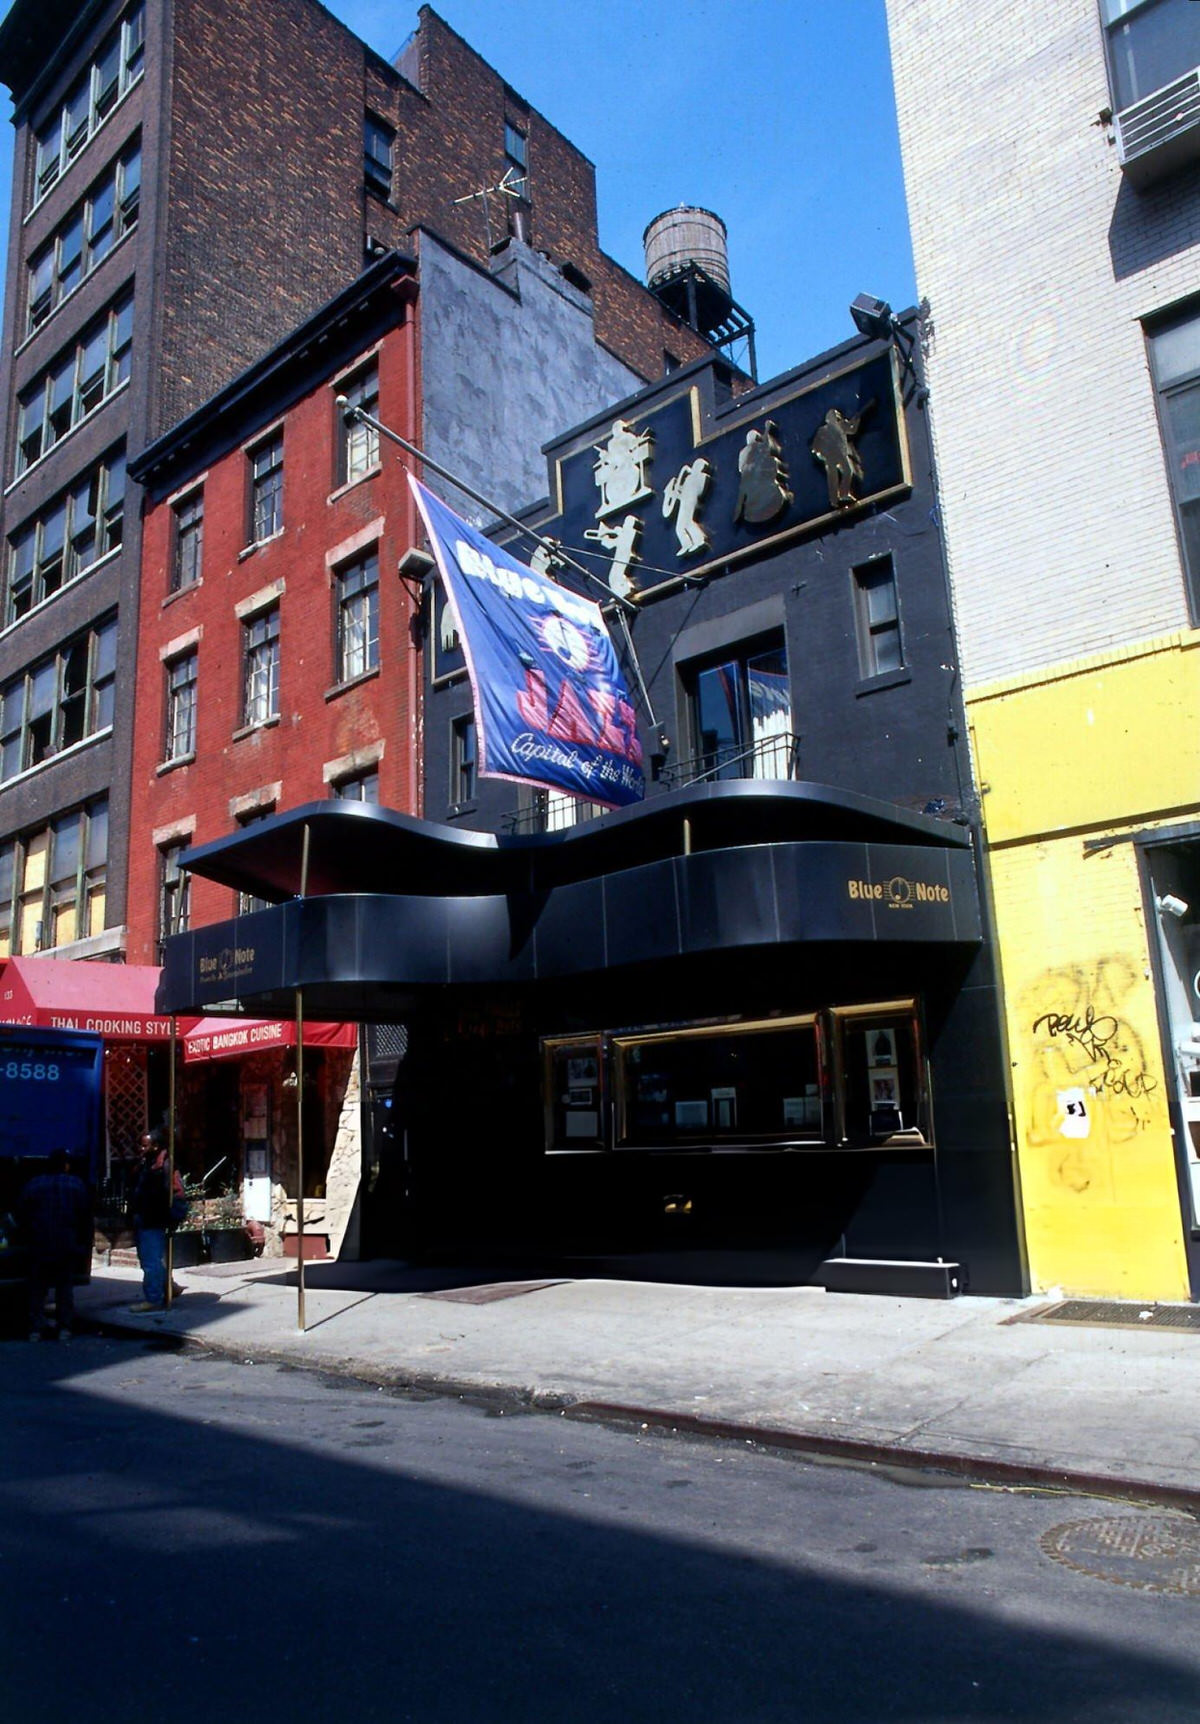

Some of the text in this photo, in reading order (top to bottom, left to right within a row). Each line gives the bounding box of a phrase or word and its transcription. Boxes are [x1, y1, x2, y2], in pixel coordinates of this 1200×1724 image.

[455, 539, 546, 604] Blue
[511, 732, 578, 769] Capital
[581, 754, 602, 779] of
[600, 760, 621, 782] the
[848, 880, 949, 901] Blue Note
[199, 947, 255, 973] Blue Note
[50, 1016, 180, 1036] THAI COOKING STYLE
[188, 1022, 283, 1054] EXOTIC BANGKOK CUISINE
